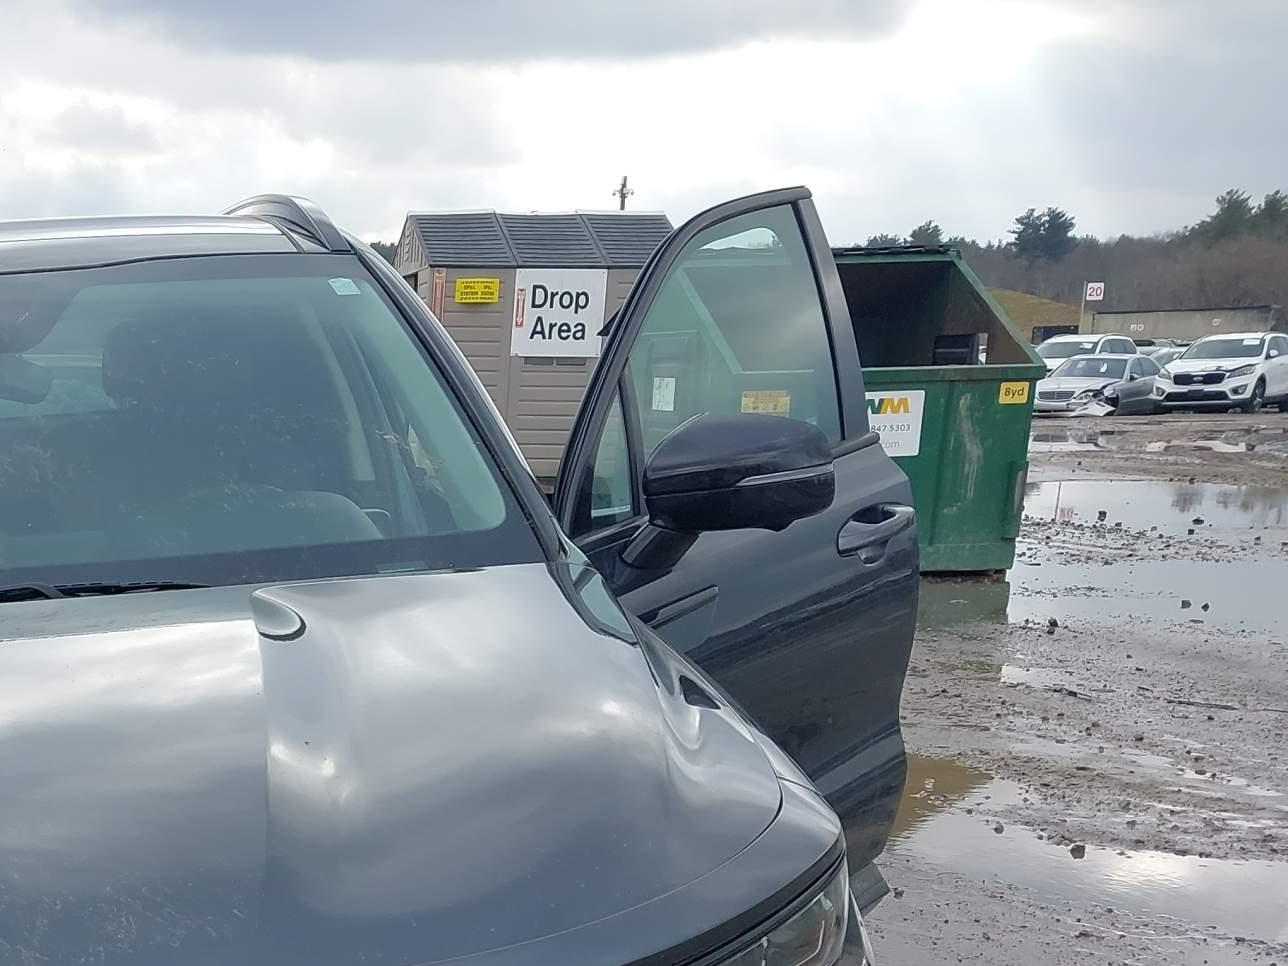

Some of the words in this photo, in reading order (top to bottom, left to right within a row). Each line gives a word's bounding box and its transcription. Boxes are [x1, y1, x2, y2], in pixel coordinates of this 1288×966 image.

[531, 284, 590, 314] Drop
[1088, 286, 1103, 296] 20
[529, 316, 586, 341] Area
[1004, 387, 1025, 399] 8yd
